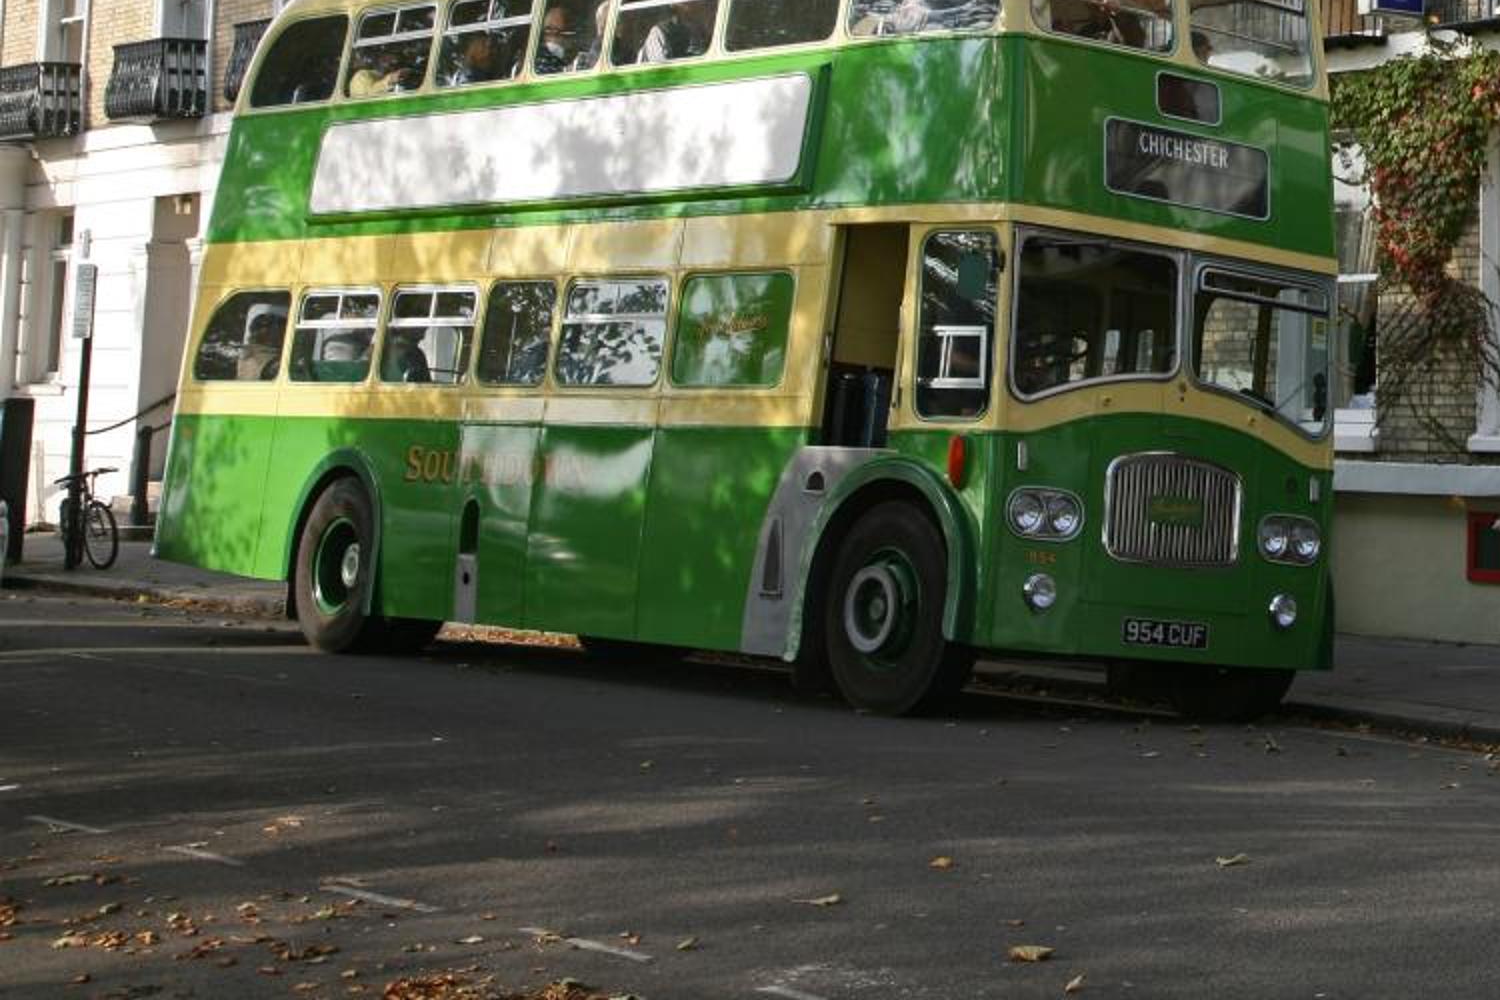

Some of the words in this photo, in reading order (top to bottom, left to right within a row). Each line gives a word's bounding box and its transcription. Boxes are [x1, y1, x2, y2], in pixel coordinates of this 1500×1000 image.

[1139, 130, 1228, 169] CHICHESTER
[1127, 621, 1164, 643] 954
[1169, 624, 1205, 645] CUF
